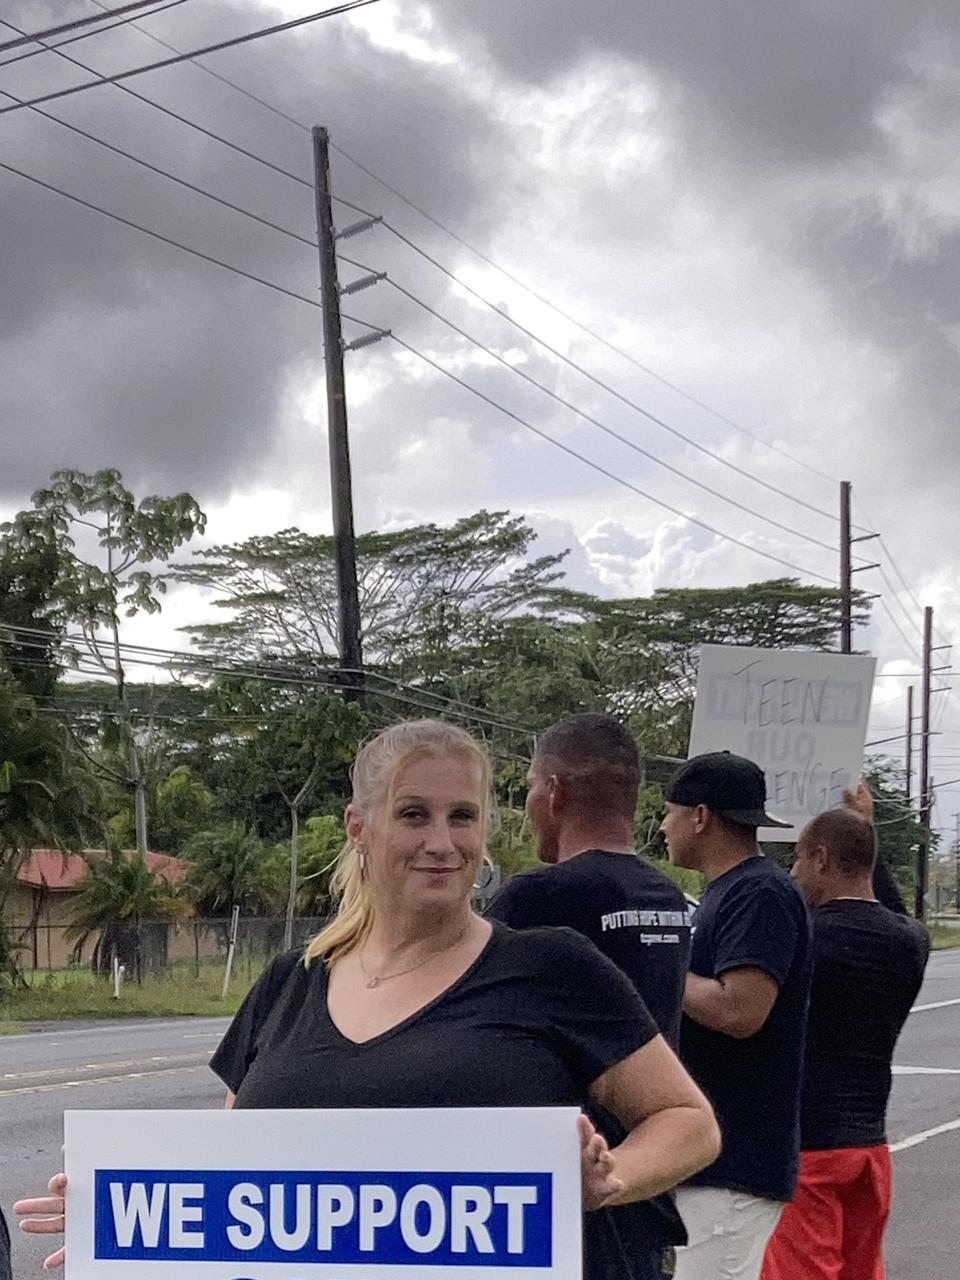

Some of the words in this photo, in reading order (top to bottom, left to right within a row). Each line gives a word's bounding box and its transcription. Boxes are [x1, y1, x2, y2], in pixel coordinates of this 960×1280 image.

[733, 660, 830, 726] TEEN
[765, 759, 845, 816] ENGE
[109, 1182, 205, 1249] WE
[226, 1183, 538, 1255] SUPPORT
